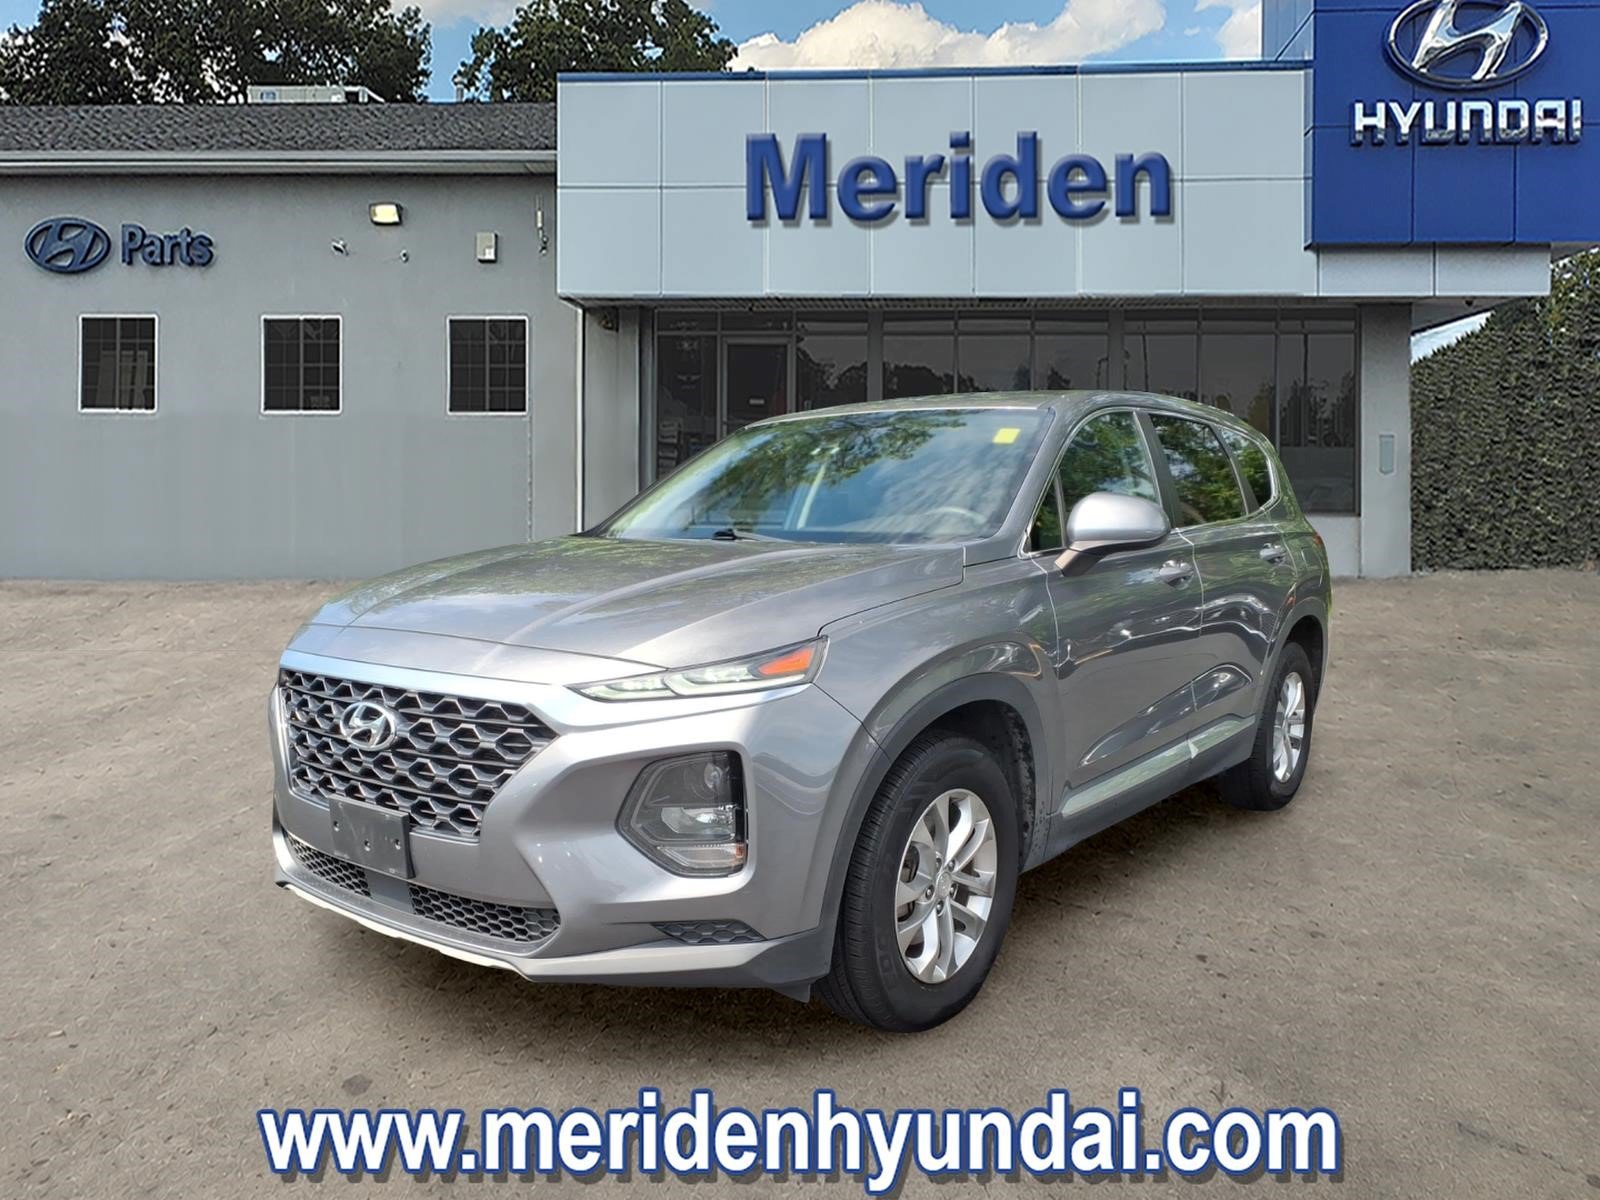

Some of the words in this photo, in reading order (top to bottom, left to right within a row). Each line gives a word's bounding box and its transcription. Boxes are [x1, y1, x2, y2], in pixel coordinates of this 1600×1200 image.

[1352, 99, 1583, 145] HYUNDAI
[746, 131, 1172, 222] Meriden
[121, 223, 214, 267] Parts
